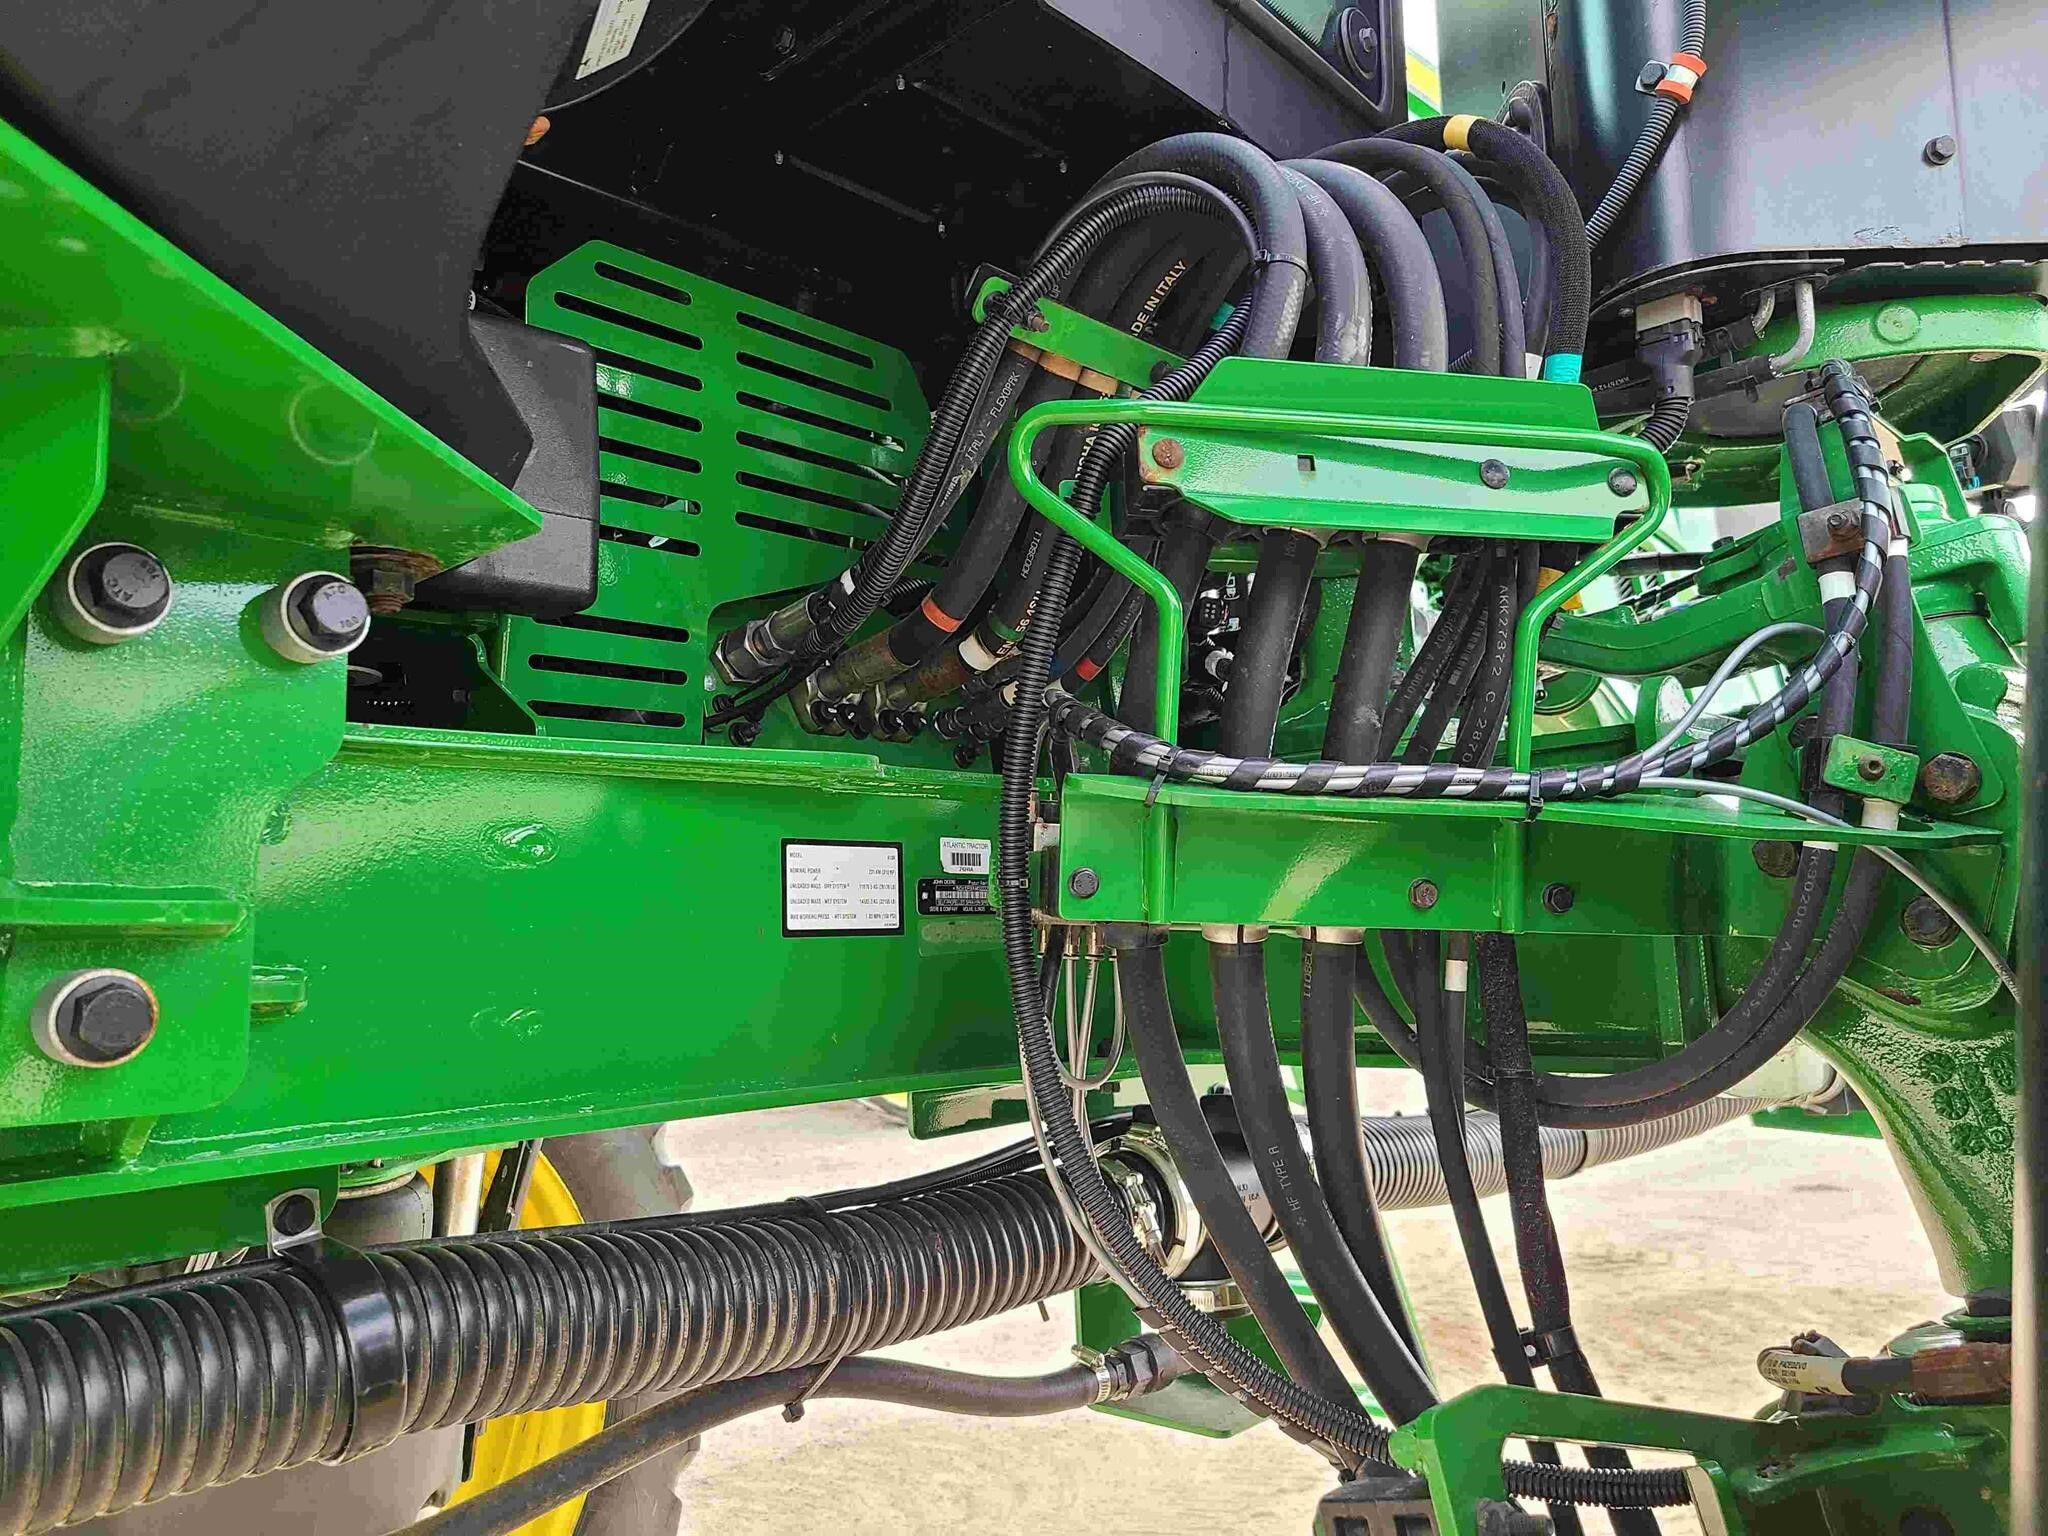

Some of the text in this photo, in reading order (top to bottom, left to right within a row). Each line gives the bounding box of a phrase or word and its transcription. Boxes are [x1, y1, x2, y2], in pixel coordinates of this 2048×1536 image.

[1143, 295, 1161, 312] IN
[1155, 260, 1187, 297] ITALY
[965, 429, 987, 462] ITALY
[989, 371, 1020, 419] FLEXOPAK
[996, 640, 1015, 656] EN
[943, 841, 966, 849] ATLANTIC
[1271, 1158, 1293, 1190] TYPE
[1285, 1195, 1301, 1212] HF
